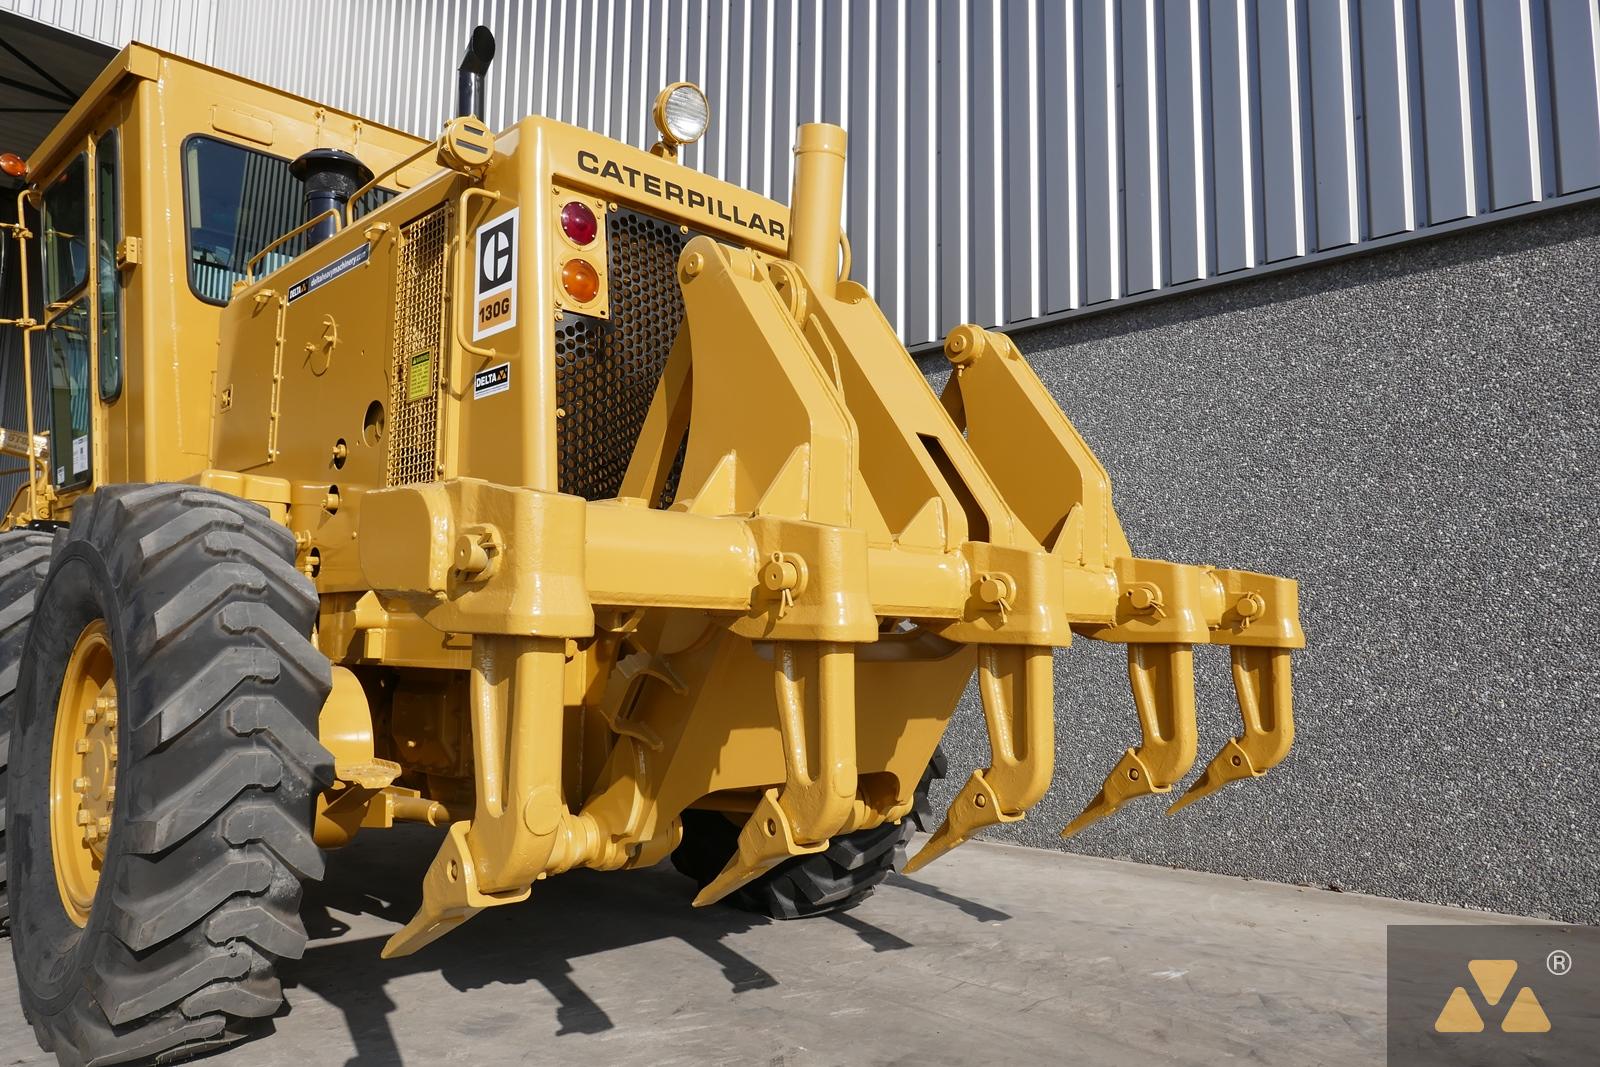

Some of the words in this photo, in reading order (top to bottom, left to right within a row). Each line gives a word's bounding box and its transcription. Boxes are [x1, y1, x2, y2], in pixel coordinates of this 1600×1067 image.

[577, 150, 786, 241] CATERPILLAR
[479, 297, 510, 323] 130G
[476, 372, 497, 388] DELTA
